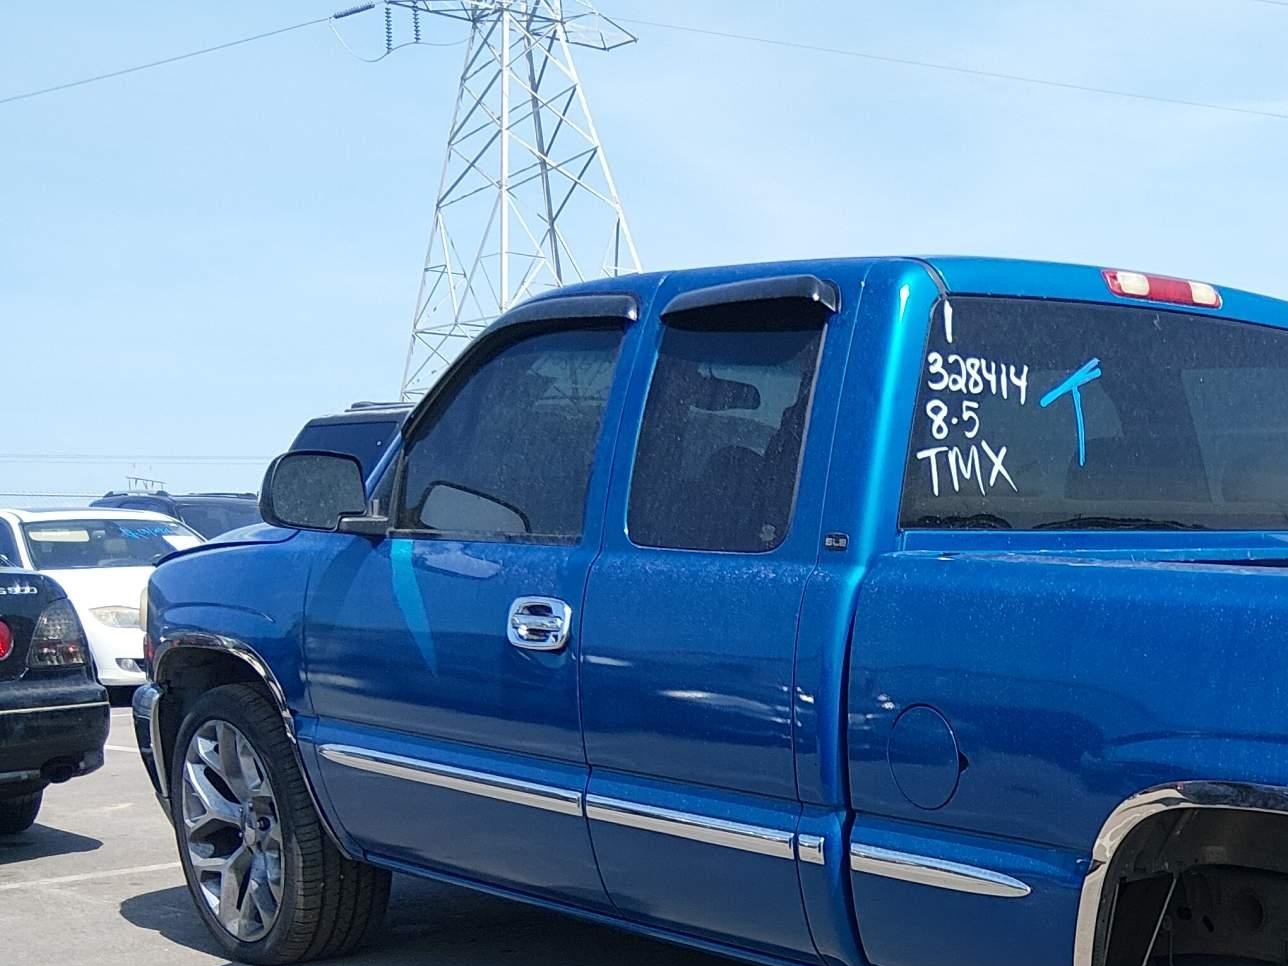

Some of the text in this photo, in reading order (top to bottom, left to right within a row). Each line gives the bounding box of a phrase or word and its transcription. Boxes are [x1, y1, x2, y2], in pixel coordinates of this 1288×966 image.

[944, 300, 952, 343] 1
[927, 352, 1028, 405] 328414
[916, 440, 1018, 496] TMX
